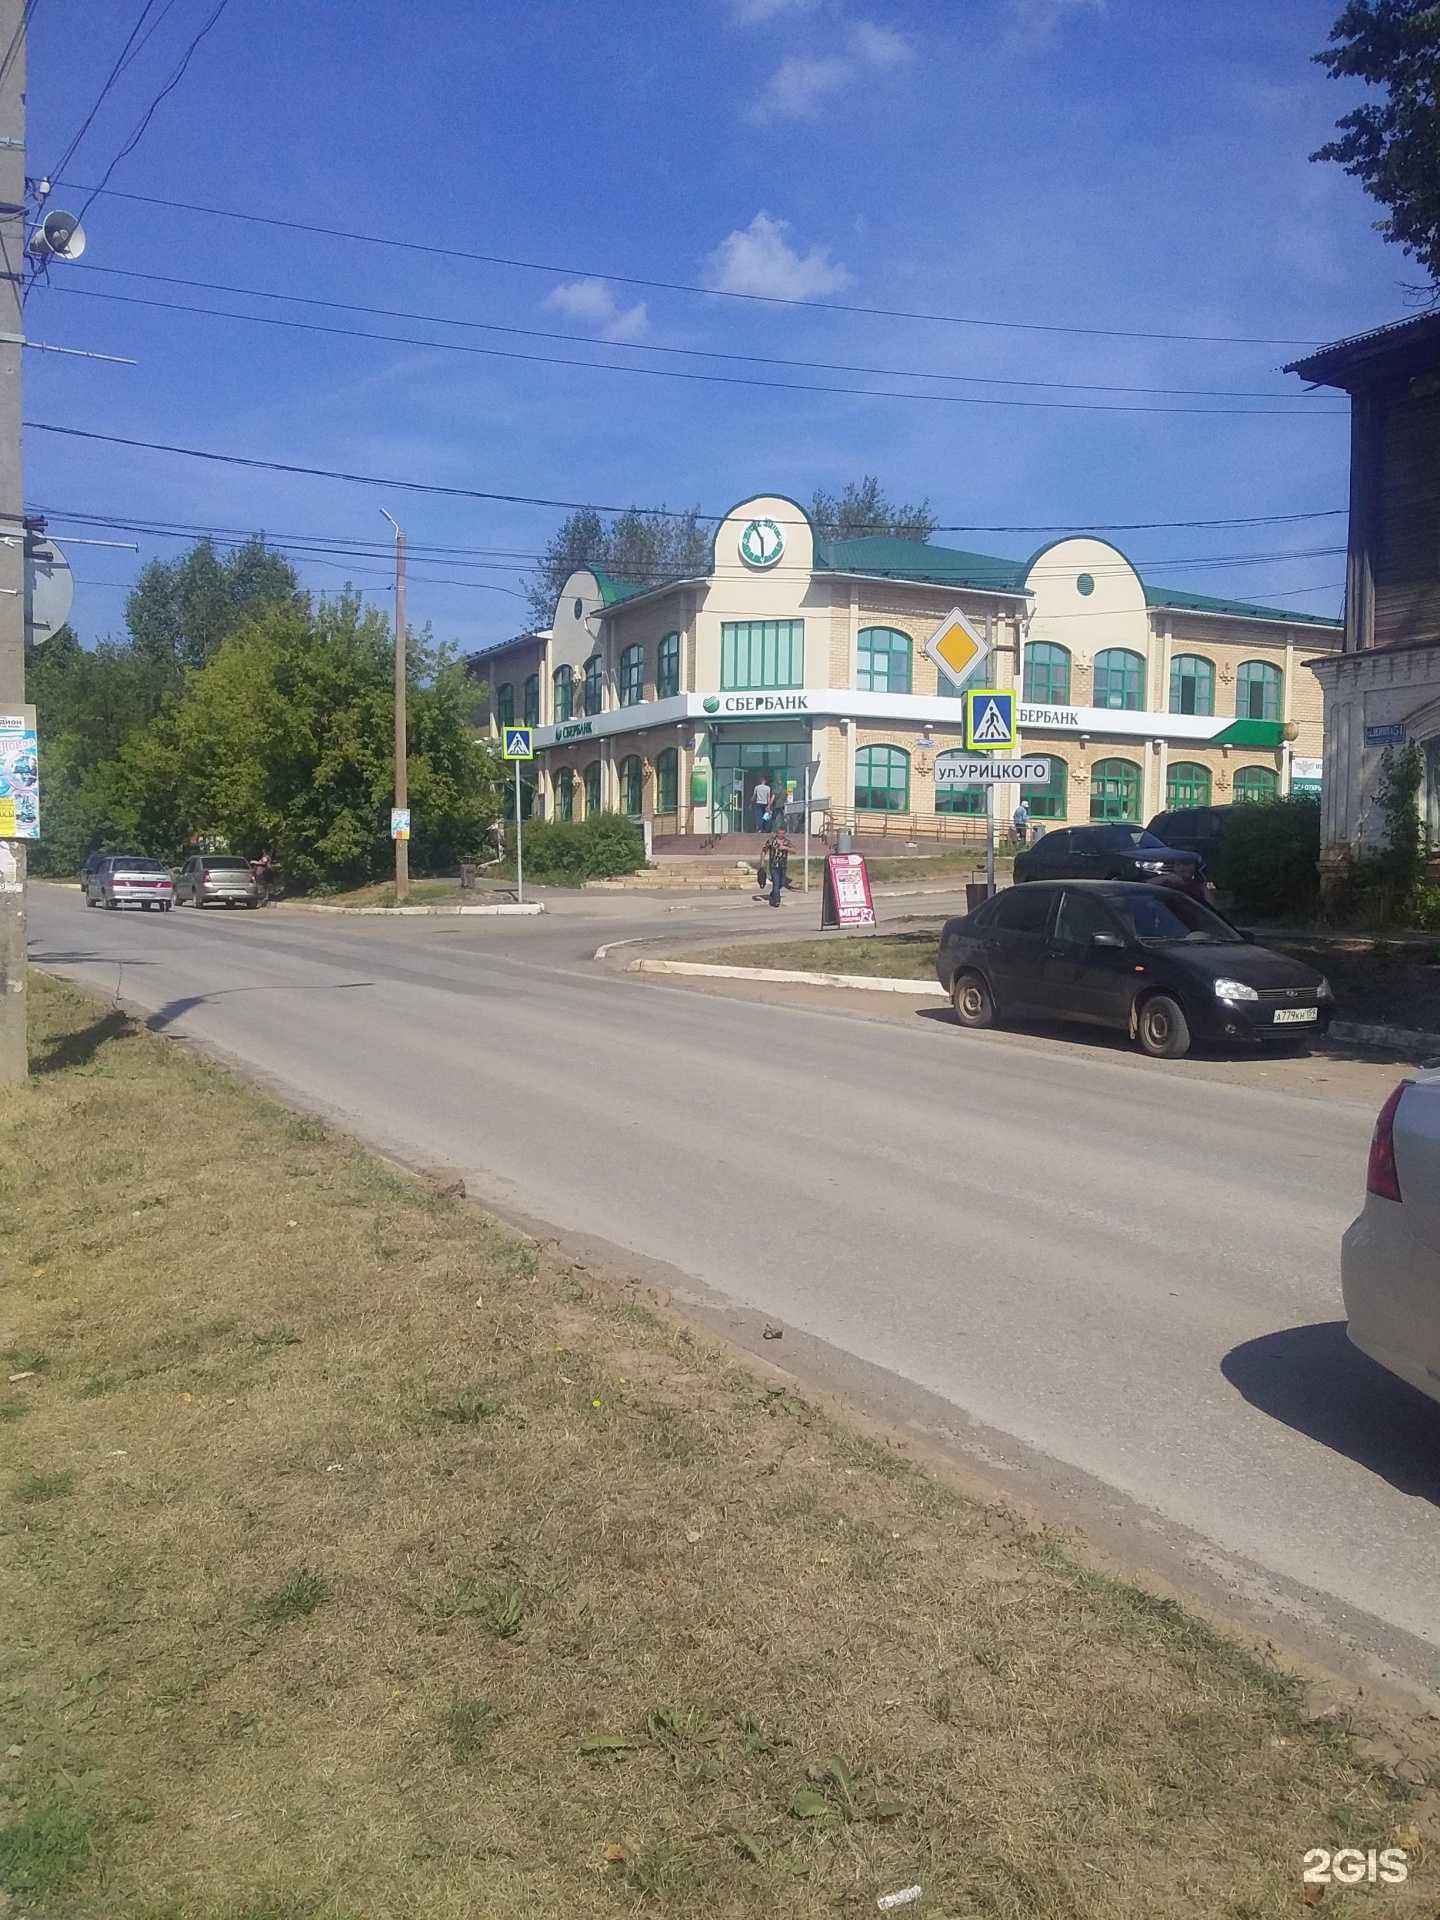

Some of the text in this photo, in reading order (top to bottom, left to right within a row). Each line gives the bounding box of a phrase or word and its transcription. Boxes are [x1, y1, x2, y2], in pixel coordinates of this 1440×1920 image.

[725, 696, 808, 711] СБЕРБАНК
[1016, 708, 1079, 725] БЕРБАНК
[939, 764, 1045, 780] ул.УРИЦКОГО
